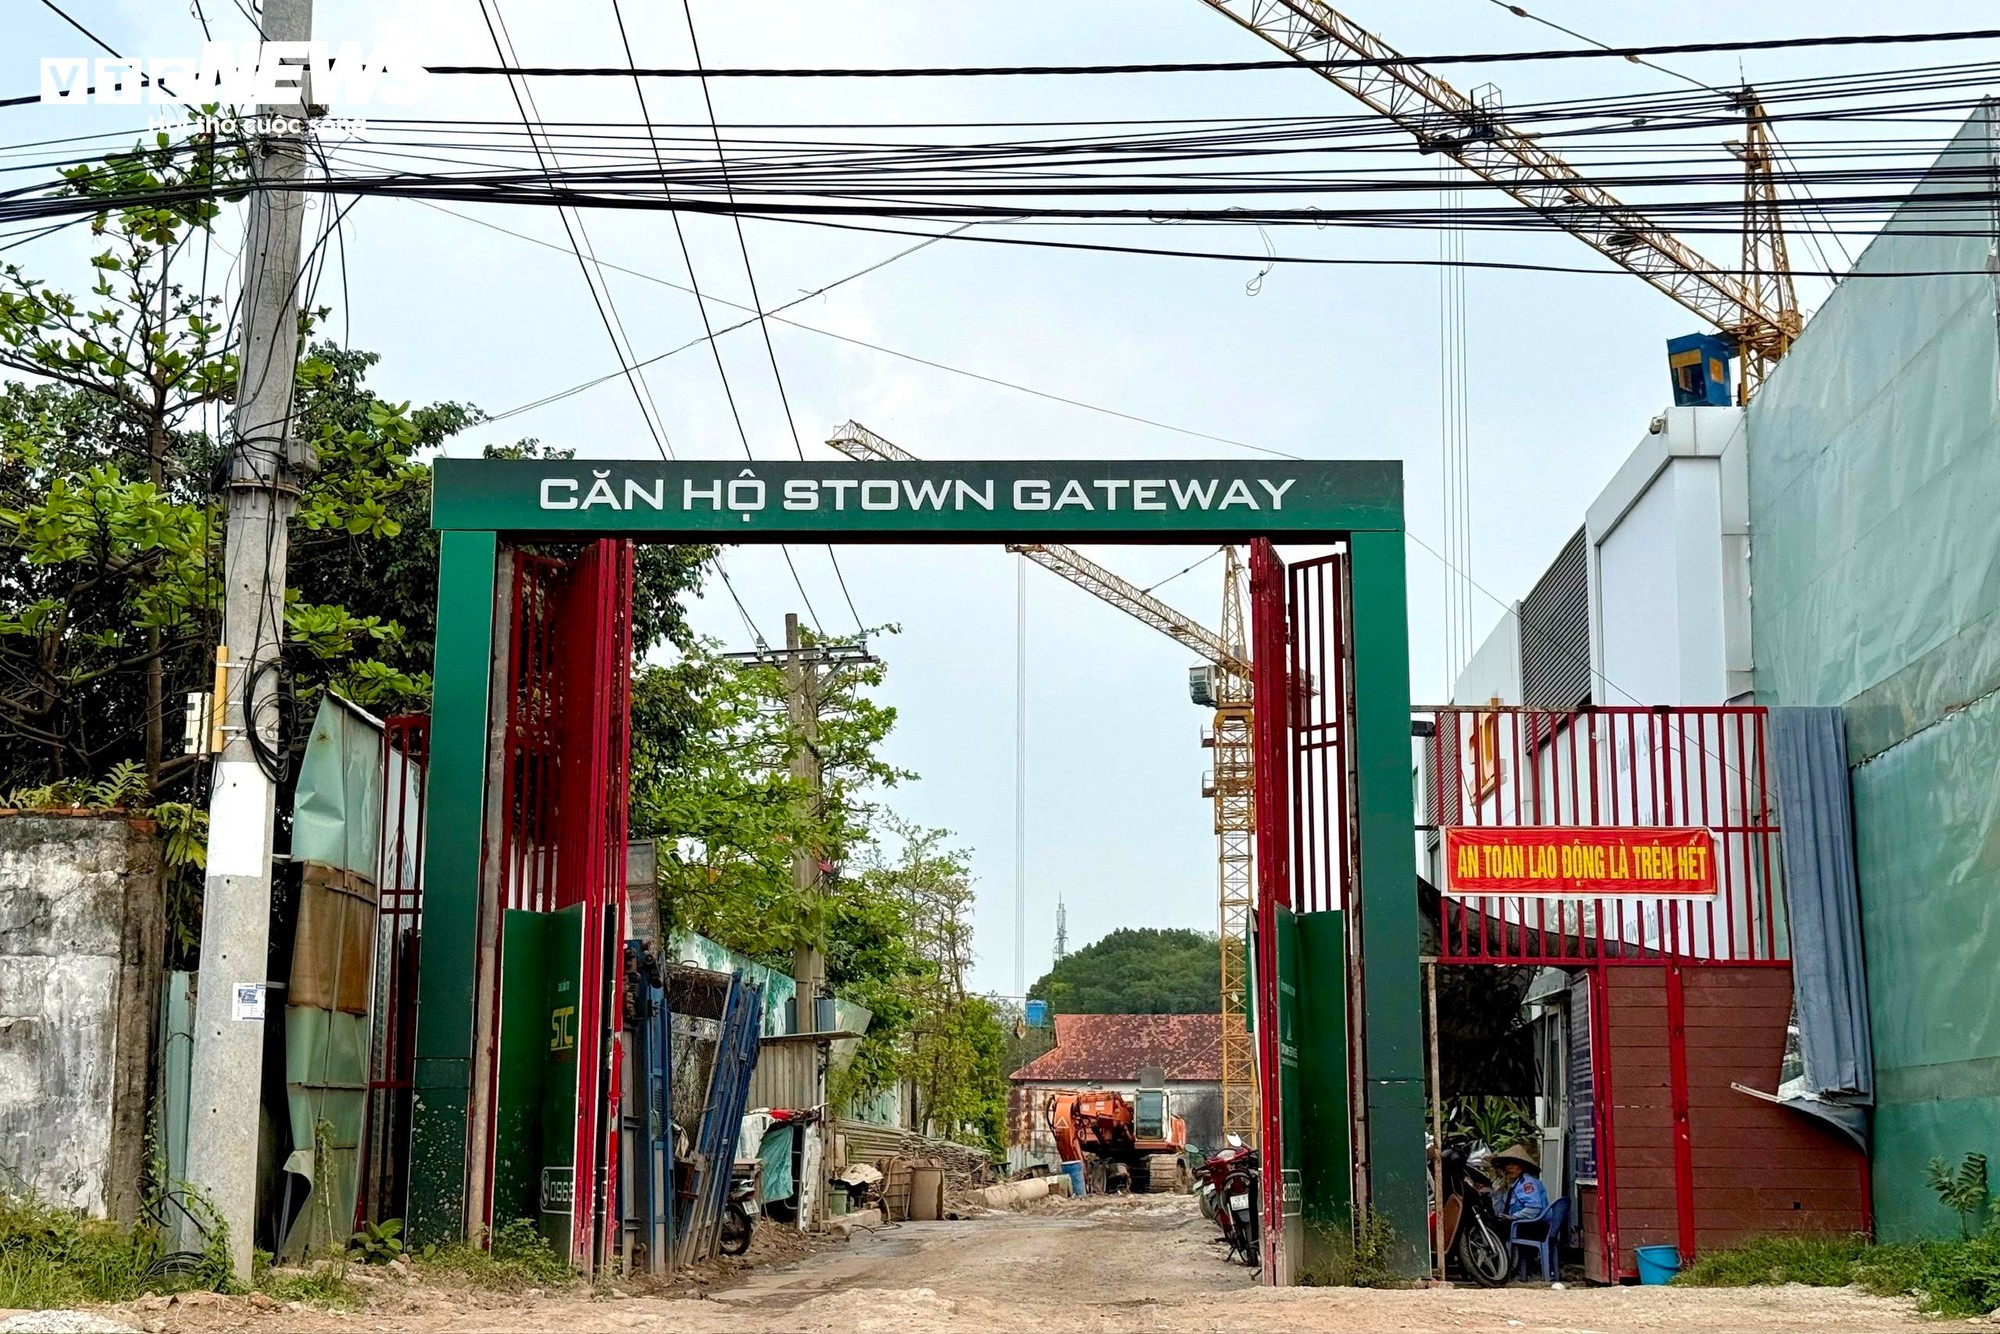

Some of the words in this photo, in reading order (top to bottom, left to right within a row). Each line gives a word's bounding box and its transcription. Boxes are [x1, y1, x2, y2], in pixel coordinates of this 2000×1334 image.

[539, 469, 664, 511] CĂN
[683, 468, 766, 522] HỘ
[783, 479, 995, 511] STOWN
[1012, 479, 1297, 511] GATEWAY
[1457, 844, 1480, 879] AN
[1482, 838, 1525, 879] TOÀN
[1527, 844, 1558, 880] LAO
[1561, 838, 1605, 887] ĐỘNG
[1610, 838, 1630, 880] LÀ
[1632, 839, 1674, 881] TRÊN
[1677, 835, 1707, 881] HẾT
